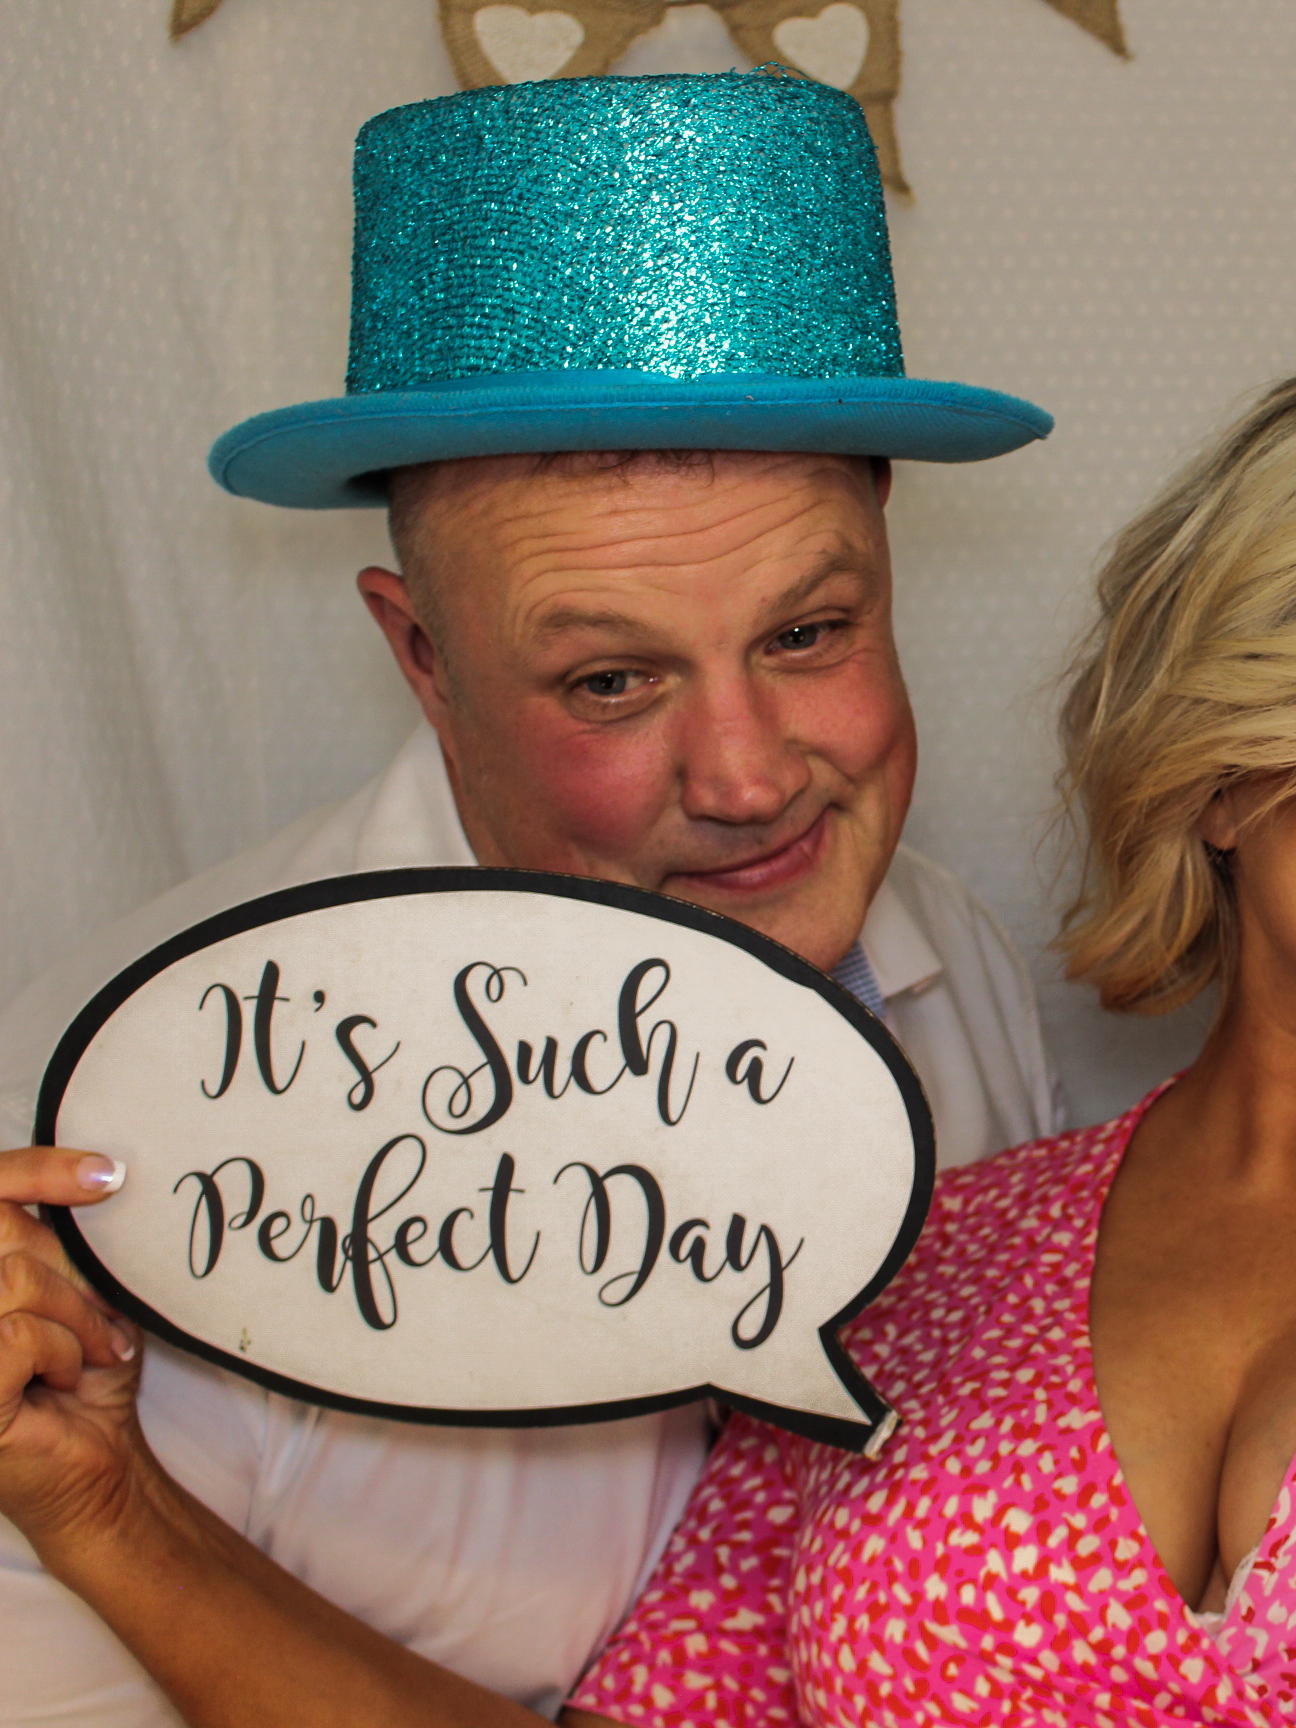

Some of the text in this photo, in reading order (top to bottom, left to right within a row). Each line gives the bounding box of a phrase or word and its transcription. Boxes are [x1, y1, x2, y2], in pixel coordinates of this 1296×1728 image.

[199, 957, 795, 1135] It's Such a
[173, 1133, 805, 1350] Perfect Day
